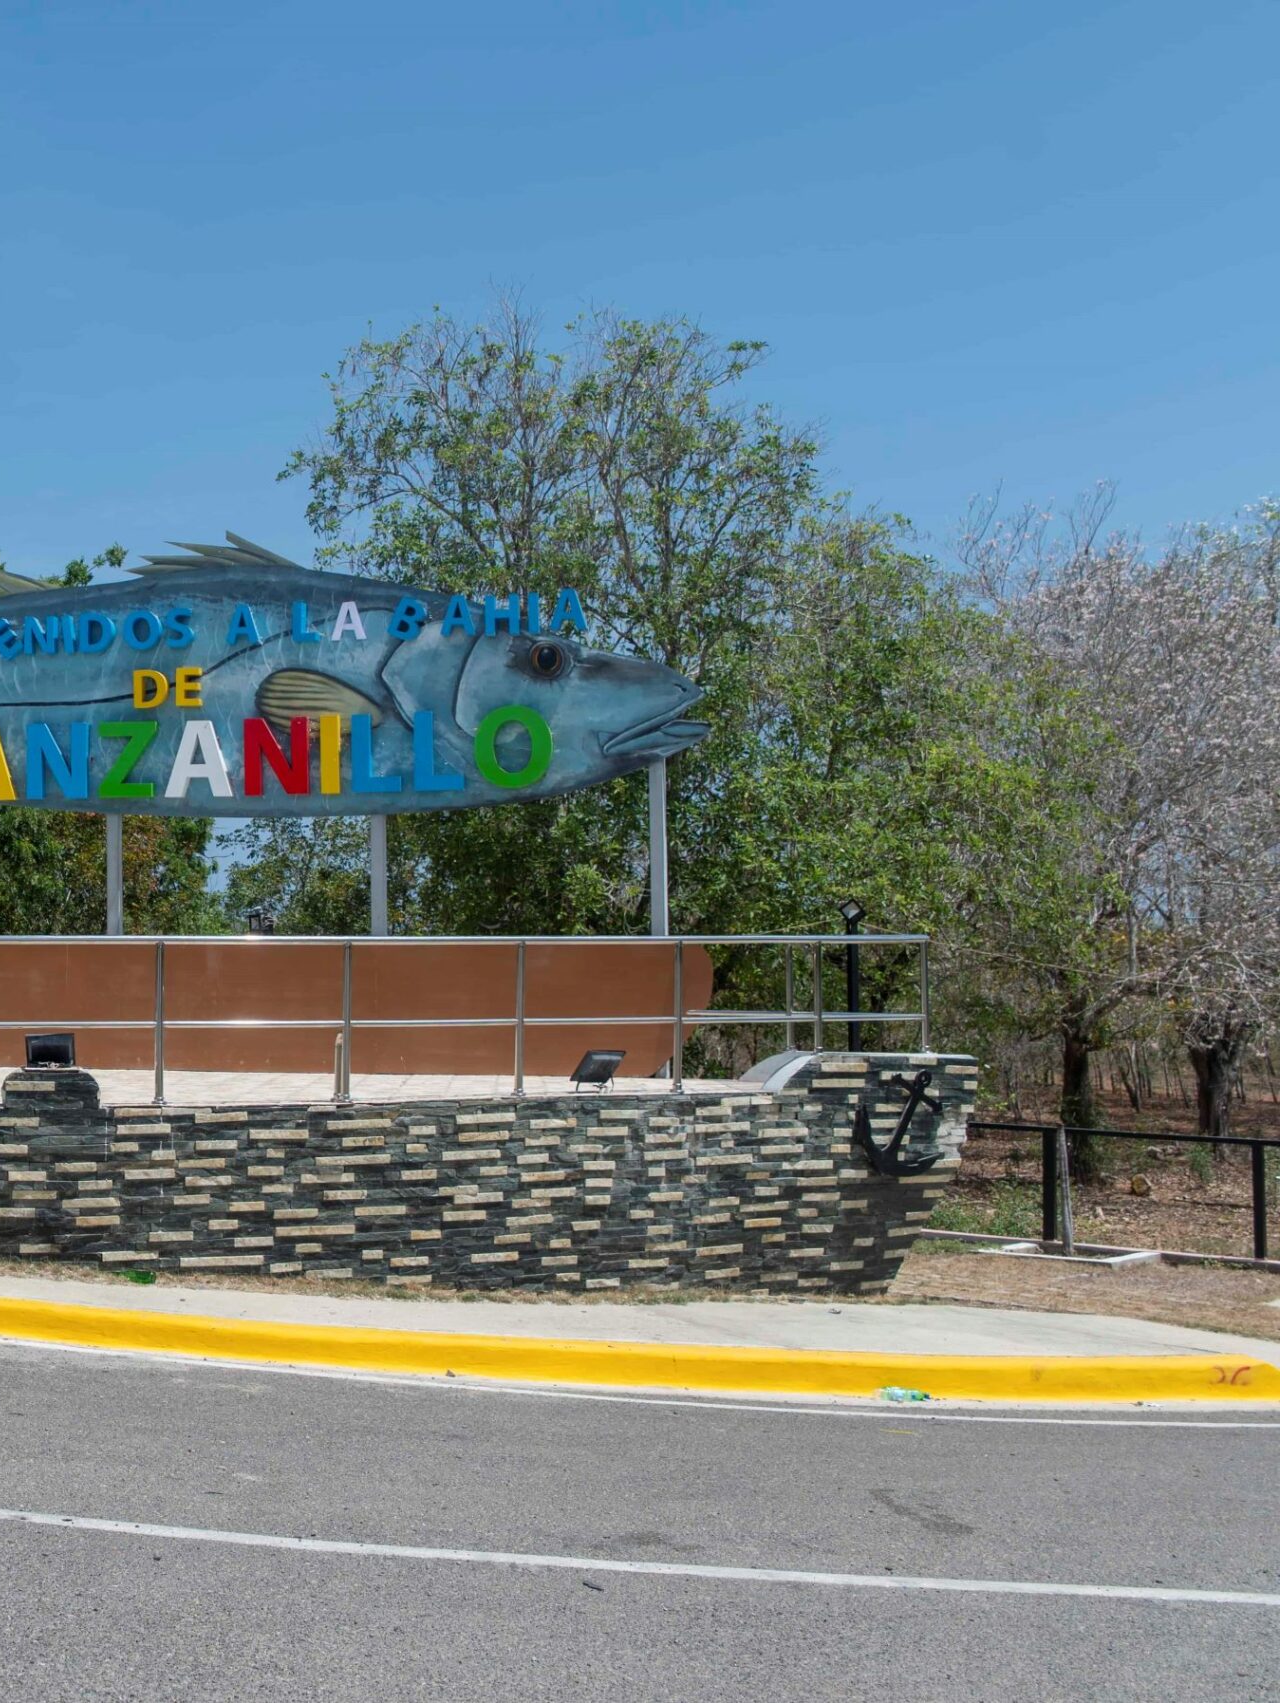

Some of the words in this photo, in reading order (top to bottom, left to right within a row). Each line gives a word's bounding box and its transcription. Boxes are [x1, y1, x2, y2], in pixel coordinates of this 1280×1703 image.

[226, 603, 262, 646] A
[292, 601, 367, 645] LA
[387, 587, 588, 641] BAHIA
[133, 666, 203, 709] DE
